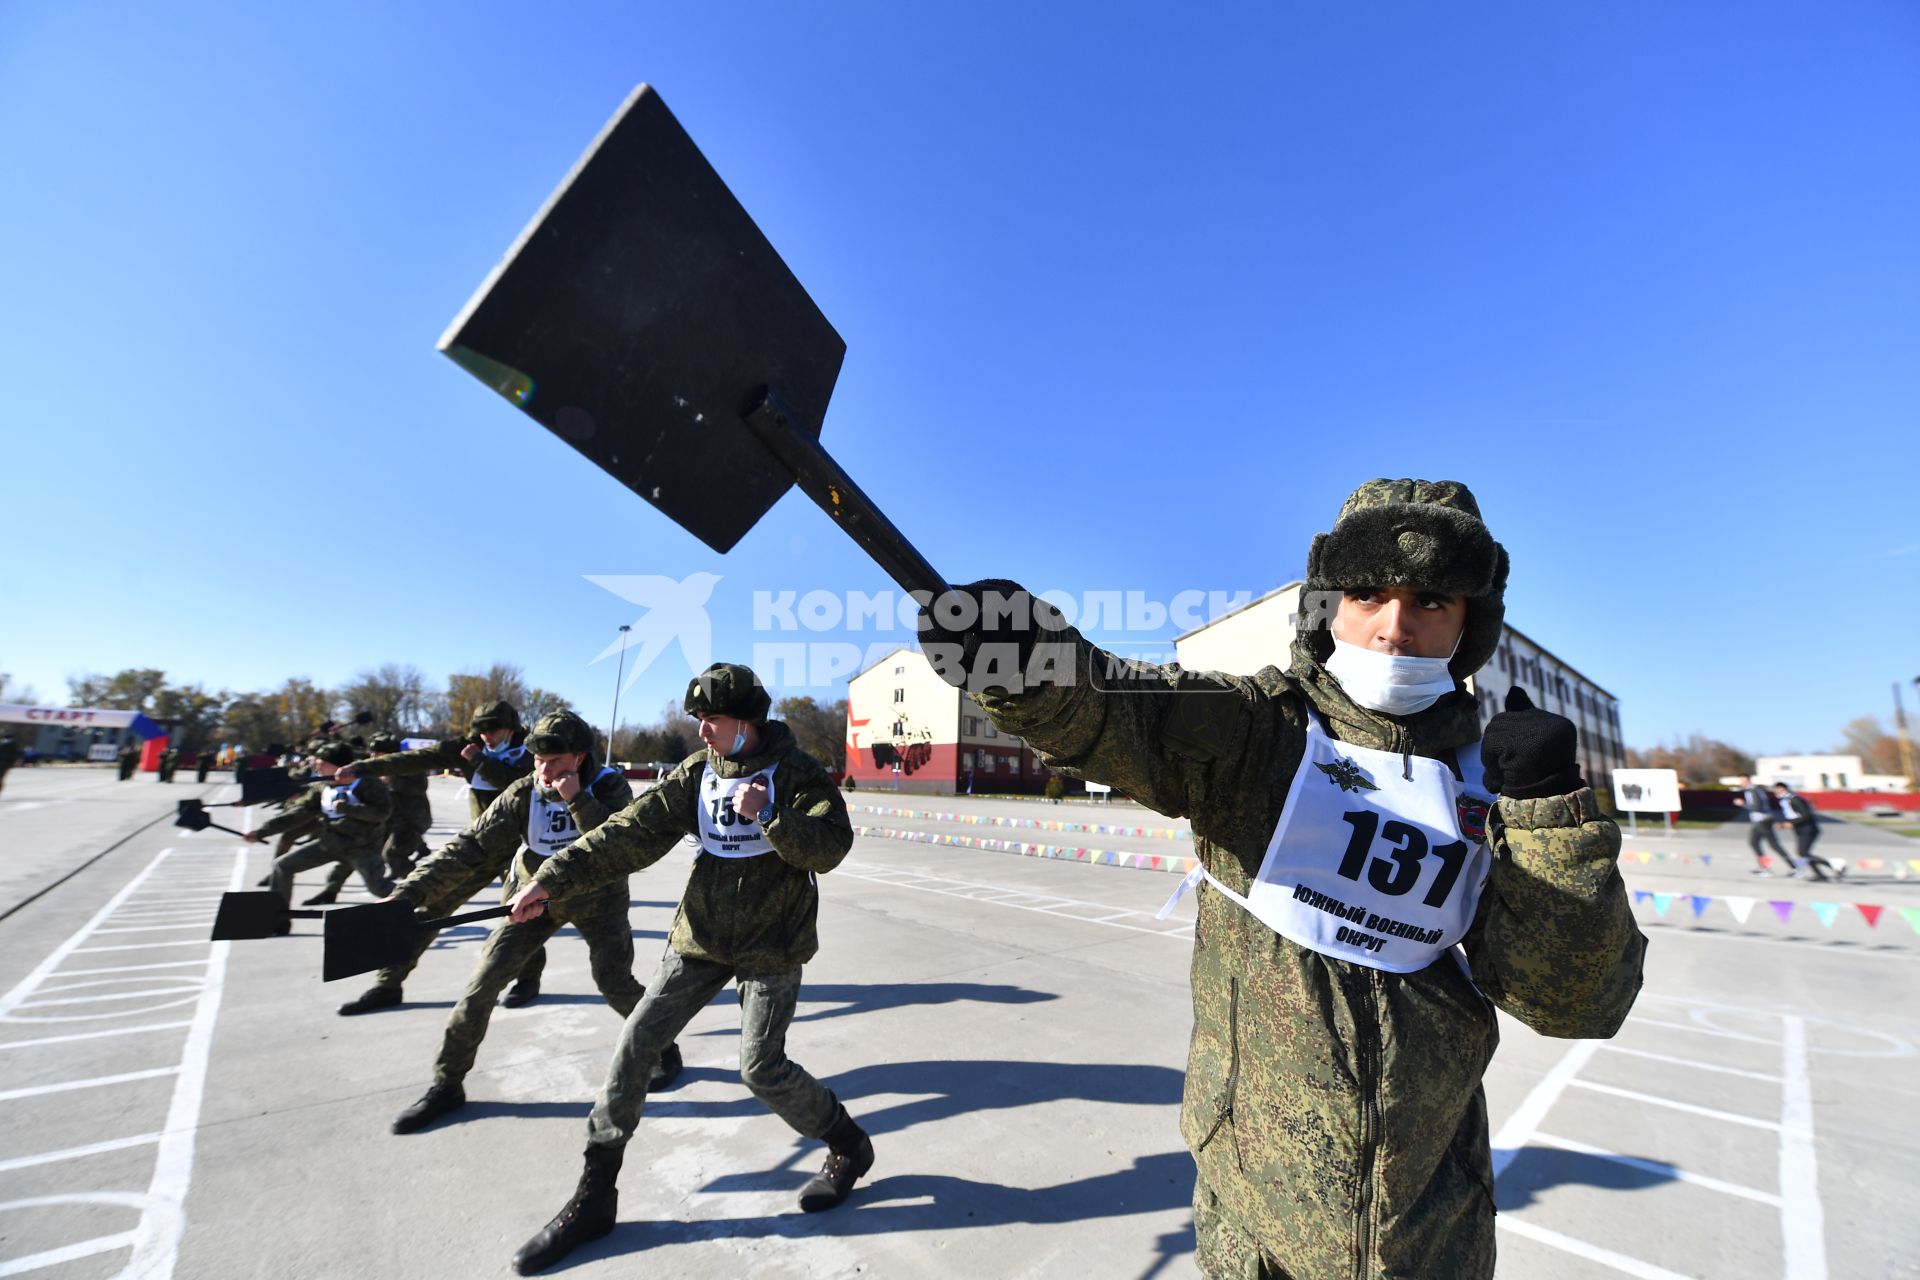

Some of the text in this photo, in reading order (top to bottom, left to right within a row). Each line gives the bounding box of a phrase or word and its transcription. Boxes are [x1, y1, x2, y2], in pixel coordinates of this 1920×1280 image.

[25, 708, 95, 722] СТАРТ
[1338, 810, 1468, 908] 131
[1292, 883, 1444, 945] ЮЖНЫЙ ВОЕННЫЙ
[1335, 925, 1388, 953] ОКРУГ
